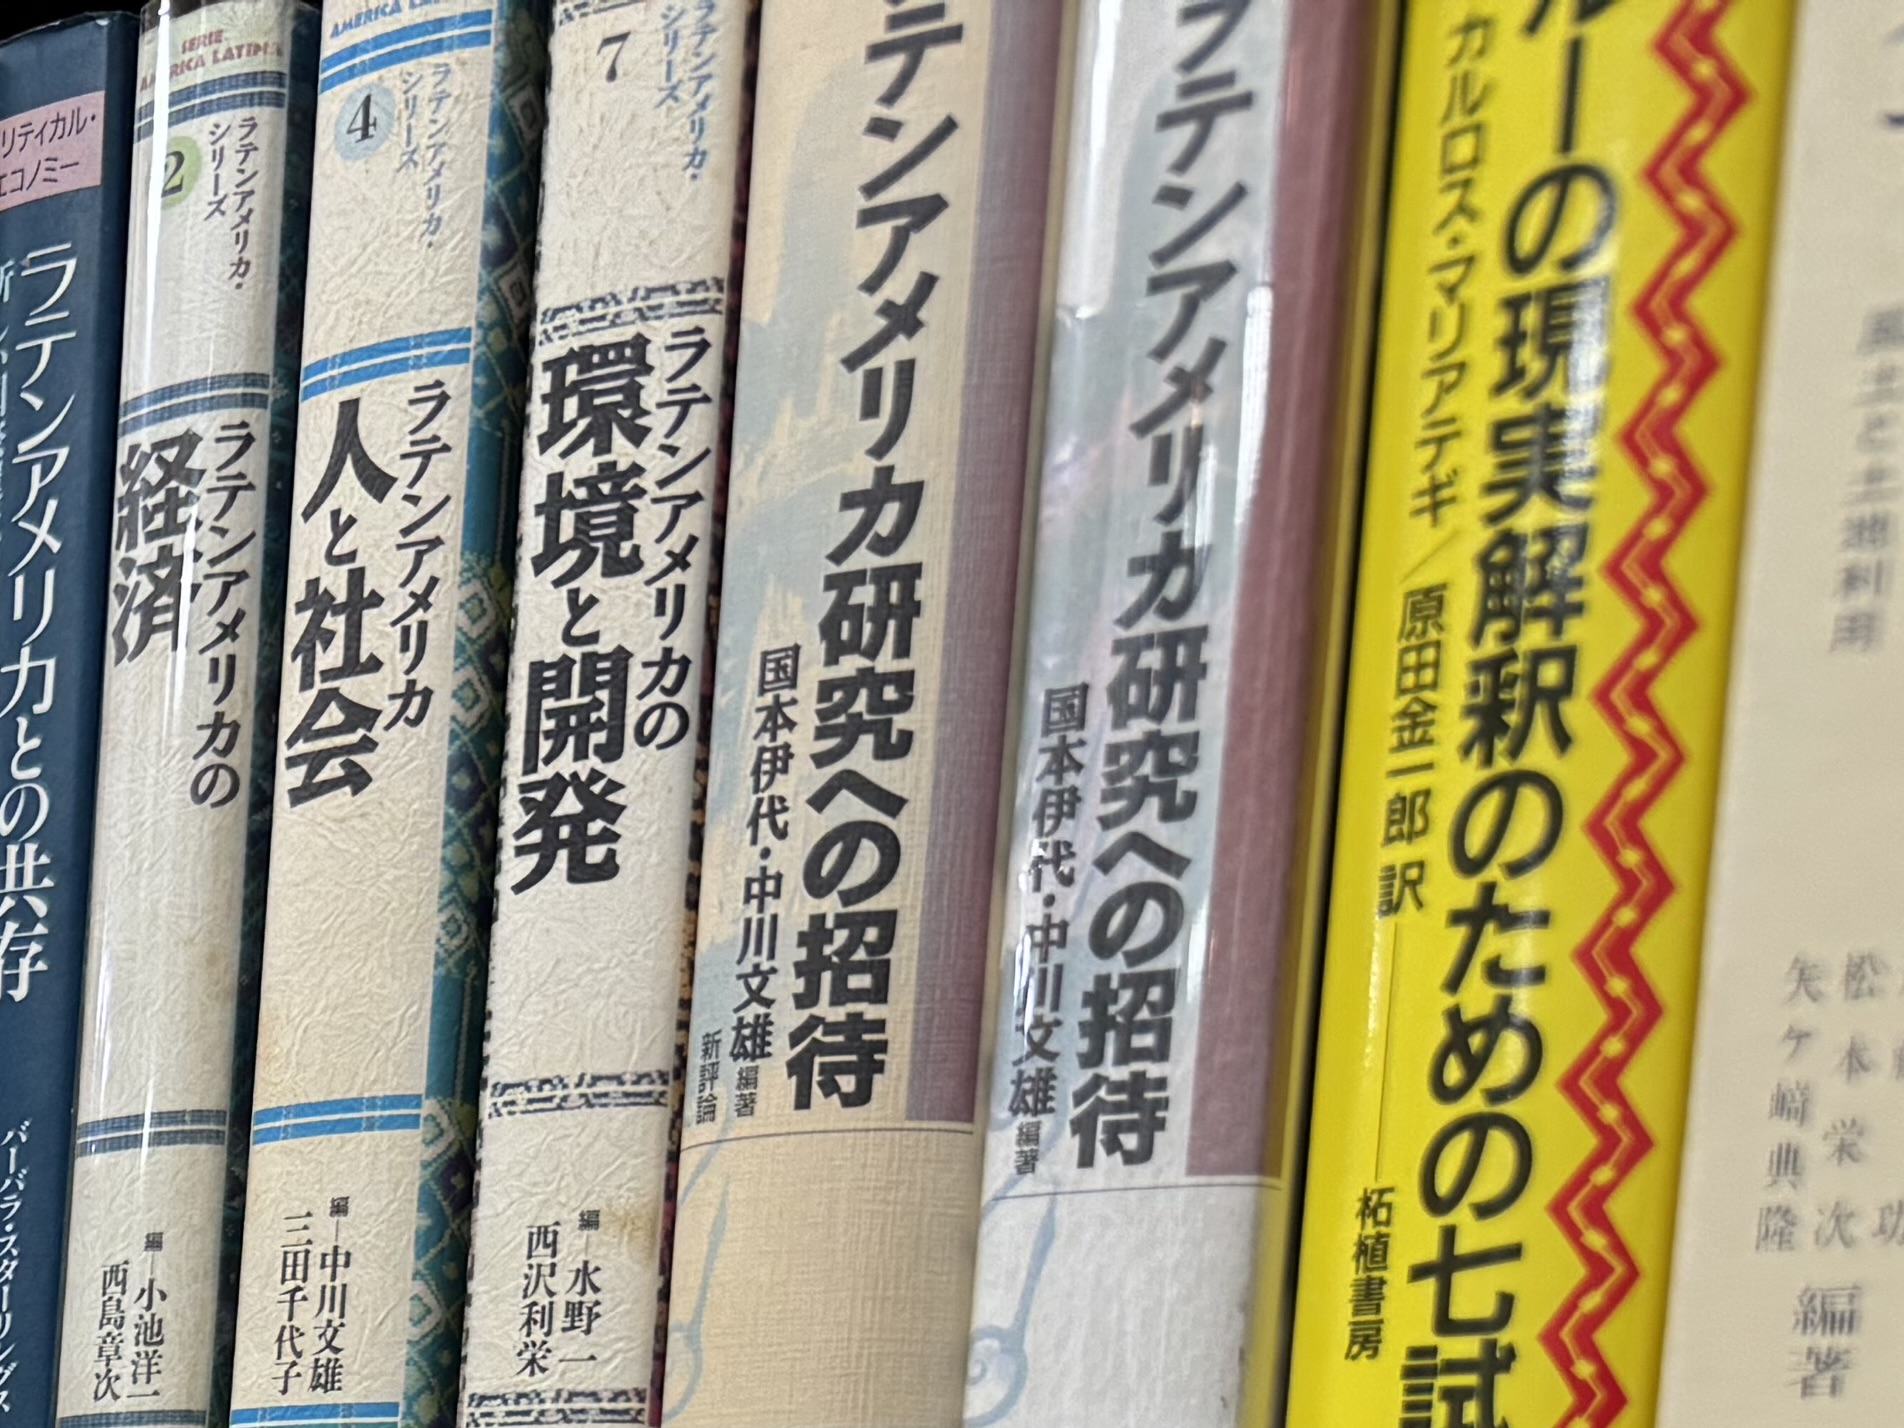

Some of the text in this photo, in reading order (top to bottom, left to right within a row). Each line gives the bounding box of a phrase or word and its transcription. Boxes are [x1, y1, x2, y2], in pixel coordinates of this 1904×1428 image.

[346, 91, 379, 147] 4
[395, 71, 426, 173] シリーズ
[594, 31, 634, 86] 7
[160, 151, 187, 199] 2
[202, 122, 233, 221] シリーズ
[1409, 13, 1496, 530] カルロス・マリアテギ
[112, 427, 206, 669] 経済
[189, 418, 259, 811] ラテンアメリカの
[283, 398, 400, 809] 人と社会
[384, 379, 454, 733] ラテンアメリカ
[510, 330, 656, 897] 環境と開発
[632, 325, 715, 752] ラテンアメリカの
[784, 0, 965, 1113] テンアメリカ研究への招待
[726, 642, 803, 1065] 国本伊代・中川文雄
[1006, 682, 1091, 1119] 国本伊代・中川文雄
[695, 1029, 724, 1126] 新評論
[1013, 1122, 1042, 1176] 編著
[1813, 948, 1888, 1252] 松本栄次
[91, 1262, 130, 1403] 西島章次
[271, 1212, 315, 1399] 三田千代子
[307, 1244, 354, 1396] 中川文雄
[514, 1221, 562, 1378] 西沢利栄
[556, 1259, 604, 1372] 水野一
[1792, 1283, 1862, 1401] 編著
